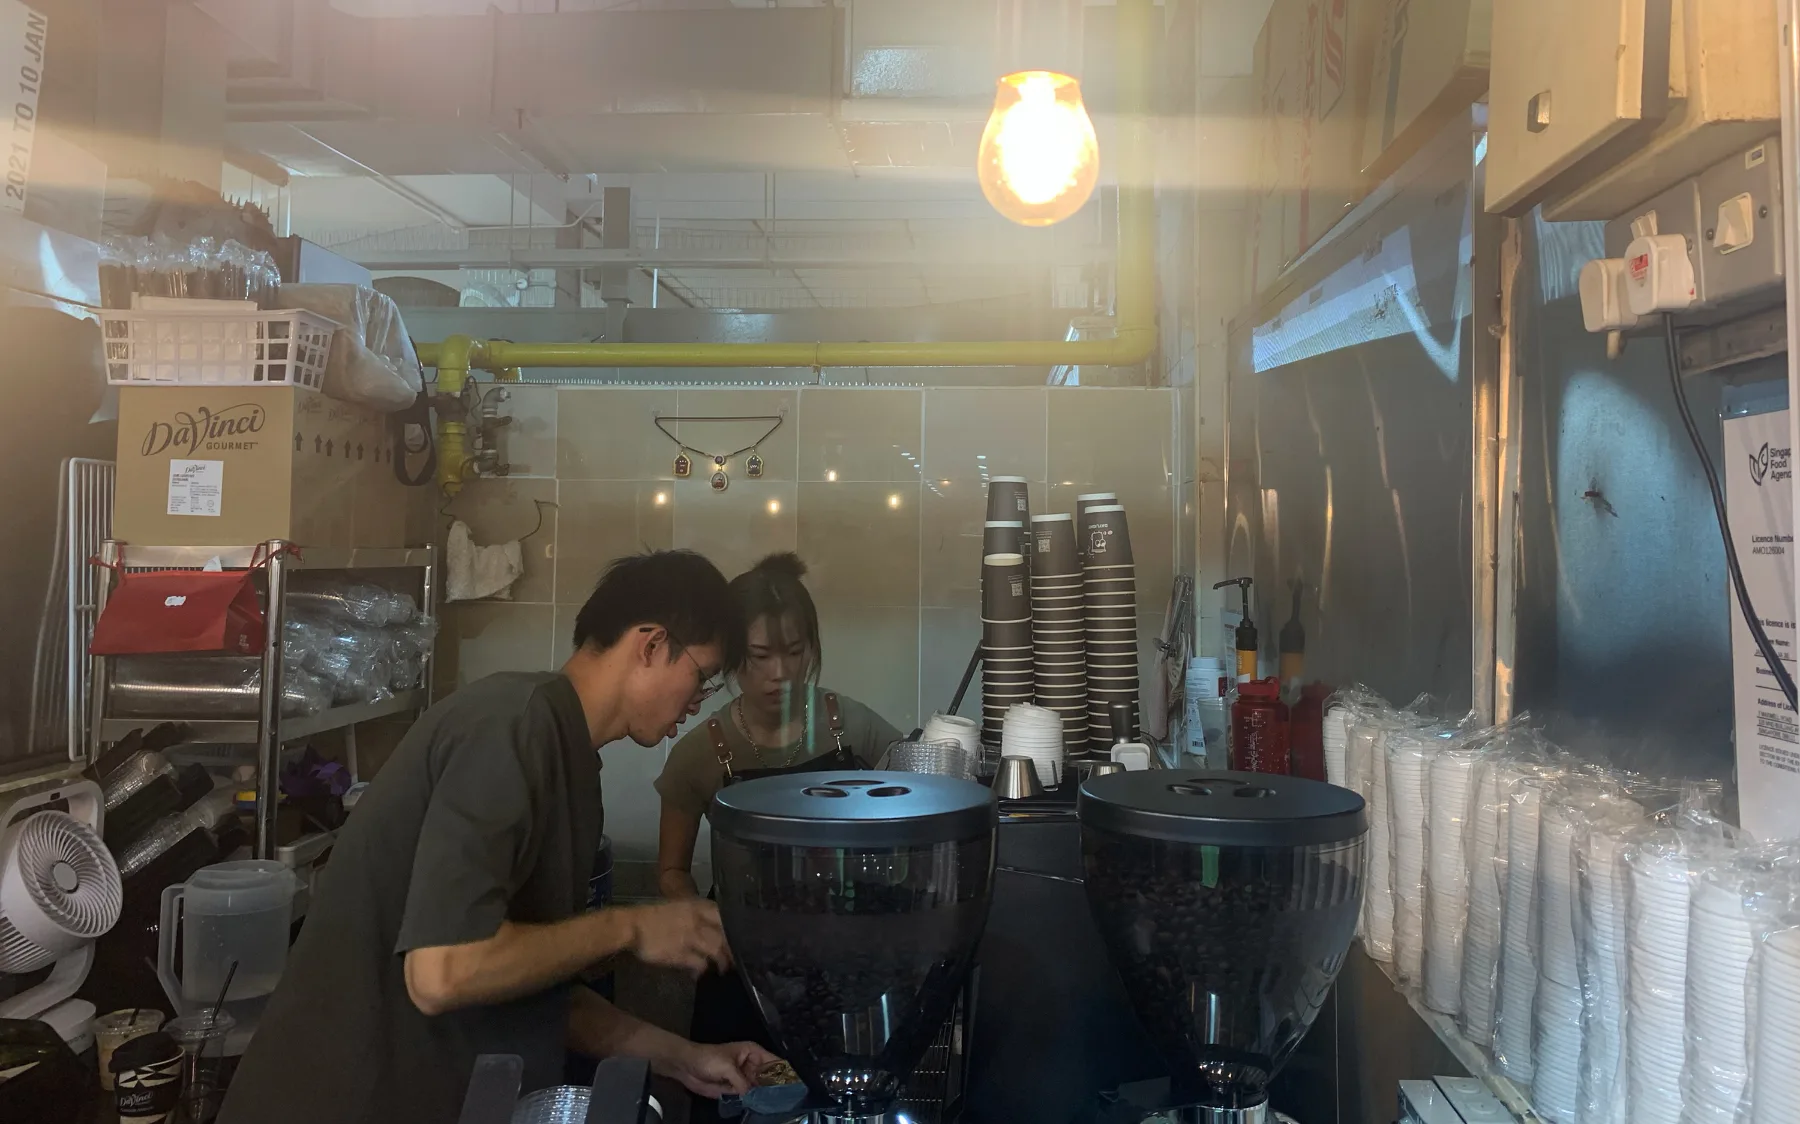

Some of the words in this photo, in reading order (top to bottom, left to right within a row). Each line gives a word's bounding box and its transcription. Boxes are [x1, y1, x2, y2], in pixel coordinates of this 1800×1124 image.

[23, 12, 46, 63] JAN
[18, 65, 39, 94] 10
[12, 102, 34, 133] TO
[5, 142, 29, 201] 2021
[141, 403, 266, 457] DaVinci
[1770, 459, 1787, 469] Food
[1751, 535, 1774, 543] Licence
